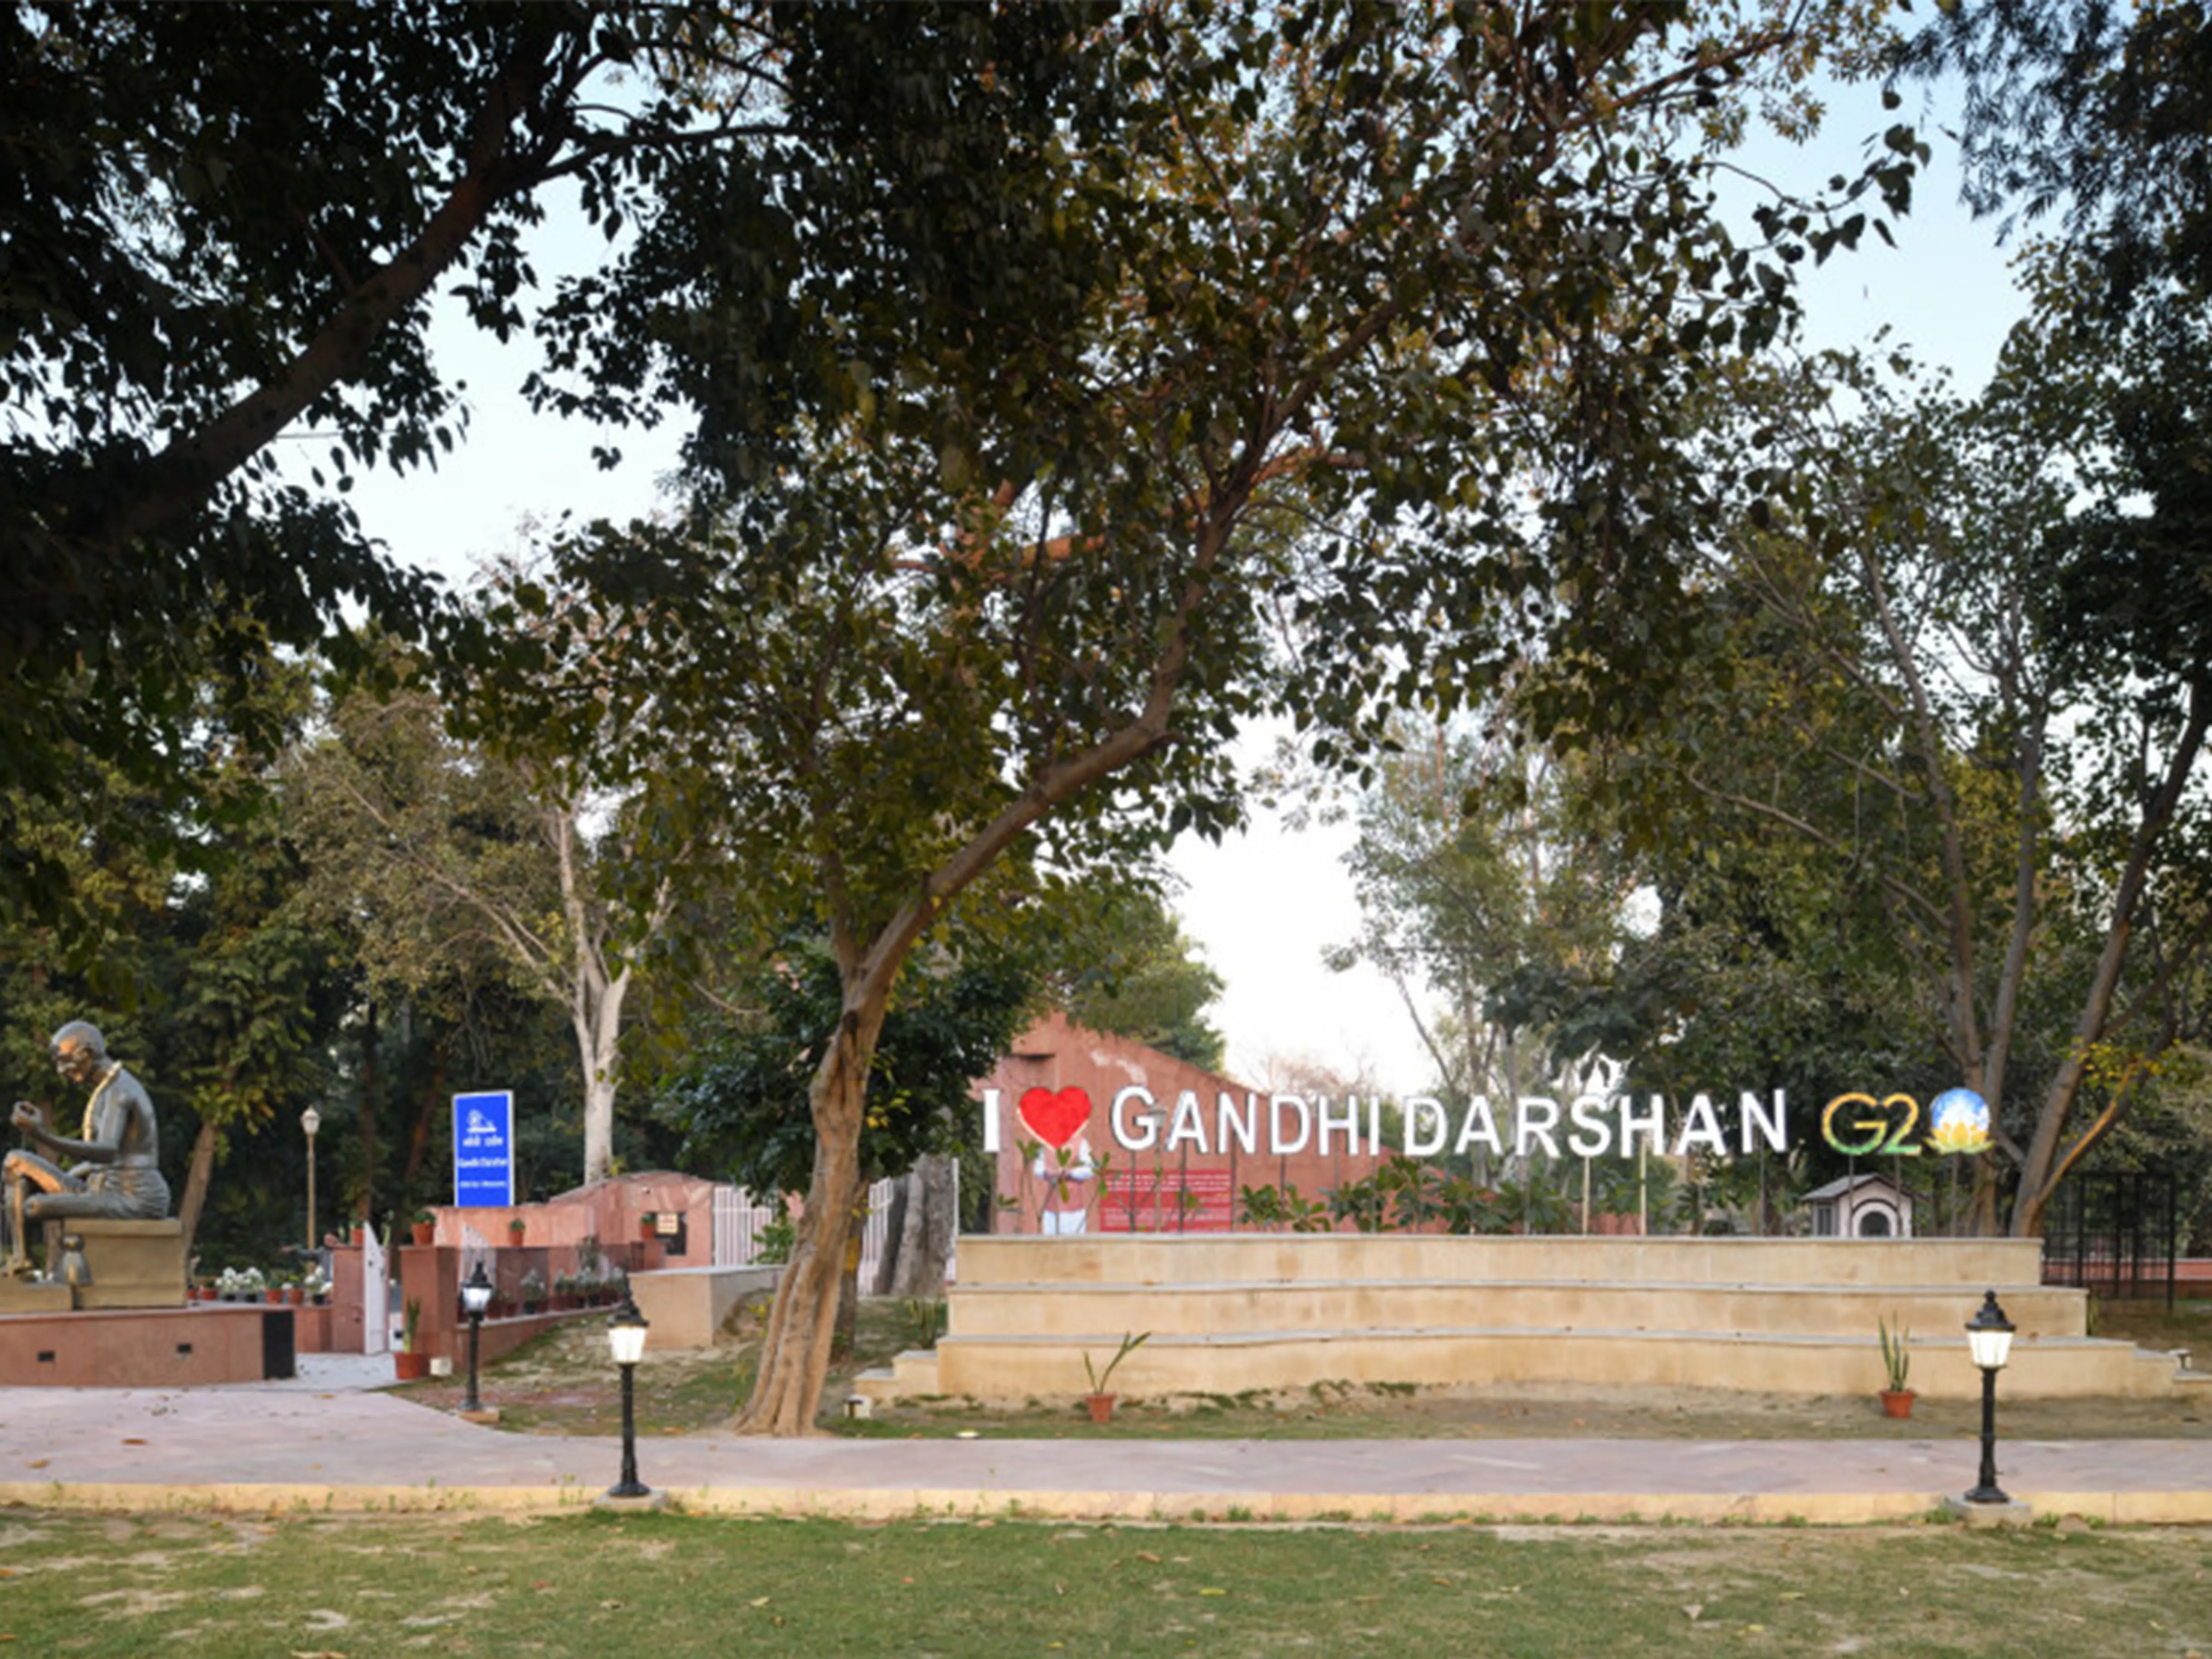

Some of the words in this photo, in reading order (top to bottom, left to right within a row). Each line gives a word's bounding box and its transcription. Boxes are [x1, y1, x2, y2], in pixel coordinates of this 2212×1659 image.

[983, 1089, 1000, 1152] I
[1111, 1086, 1379, 1156] GANDHI
[1403, 1088, 1787, 1158] DARSHAN
